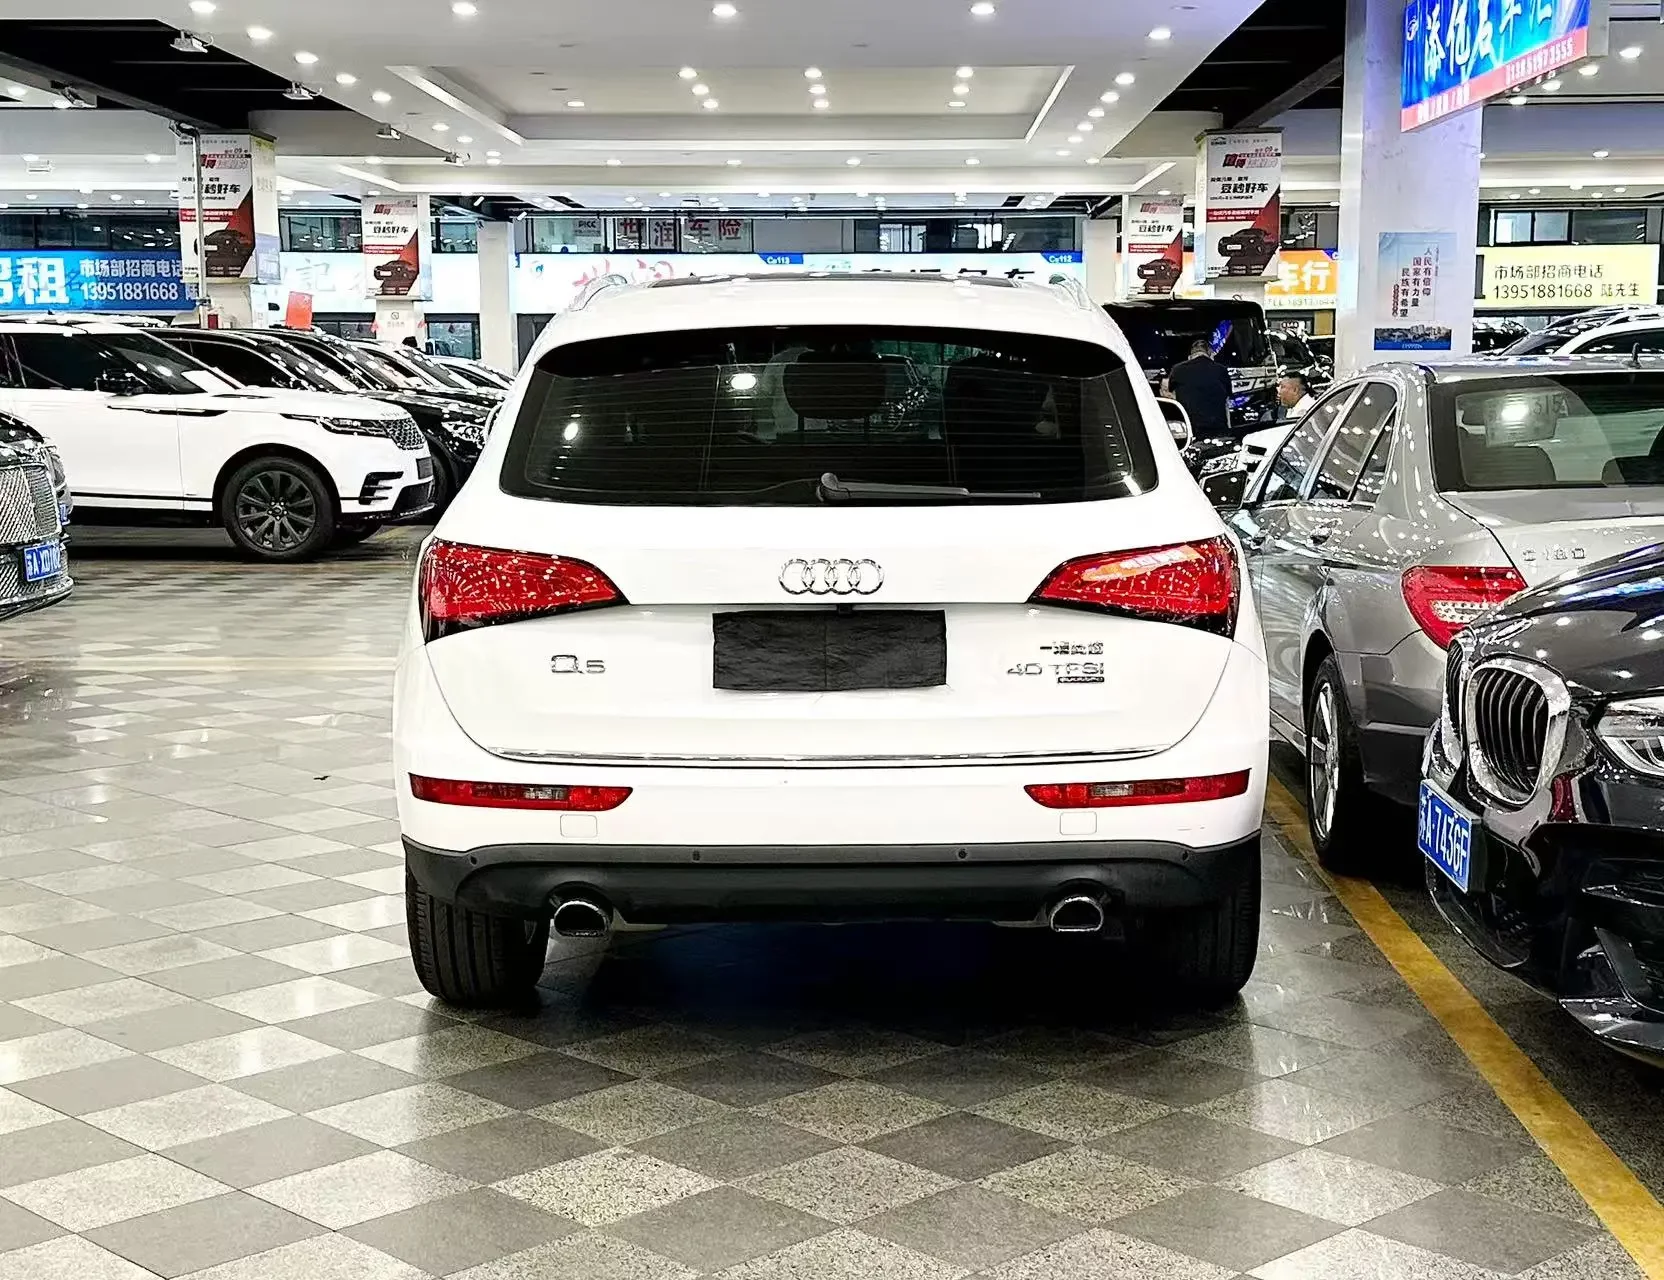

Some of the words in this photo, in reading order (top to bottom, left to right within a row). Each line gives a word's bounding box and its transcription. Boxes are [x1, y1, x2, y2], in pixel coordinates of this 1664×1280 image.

[0, 257, 69, 304] 租
[1494, 264, 1604, 280] 市场部招商电话
[81, 281, 179, 300] 13951881668
[1494, 283, 1593, 299] 13951881668
[1600, 283, 1640, 298] 陆先生
[551, 654, 606, 674] Q5
[1048, 662, 1104, 675] TFSI
